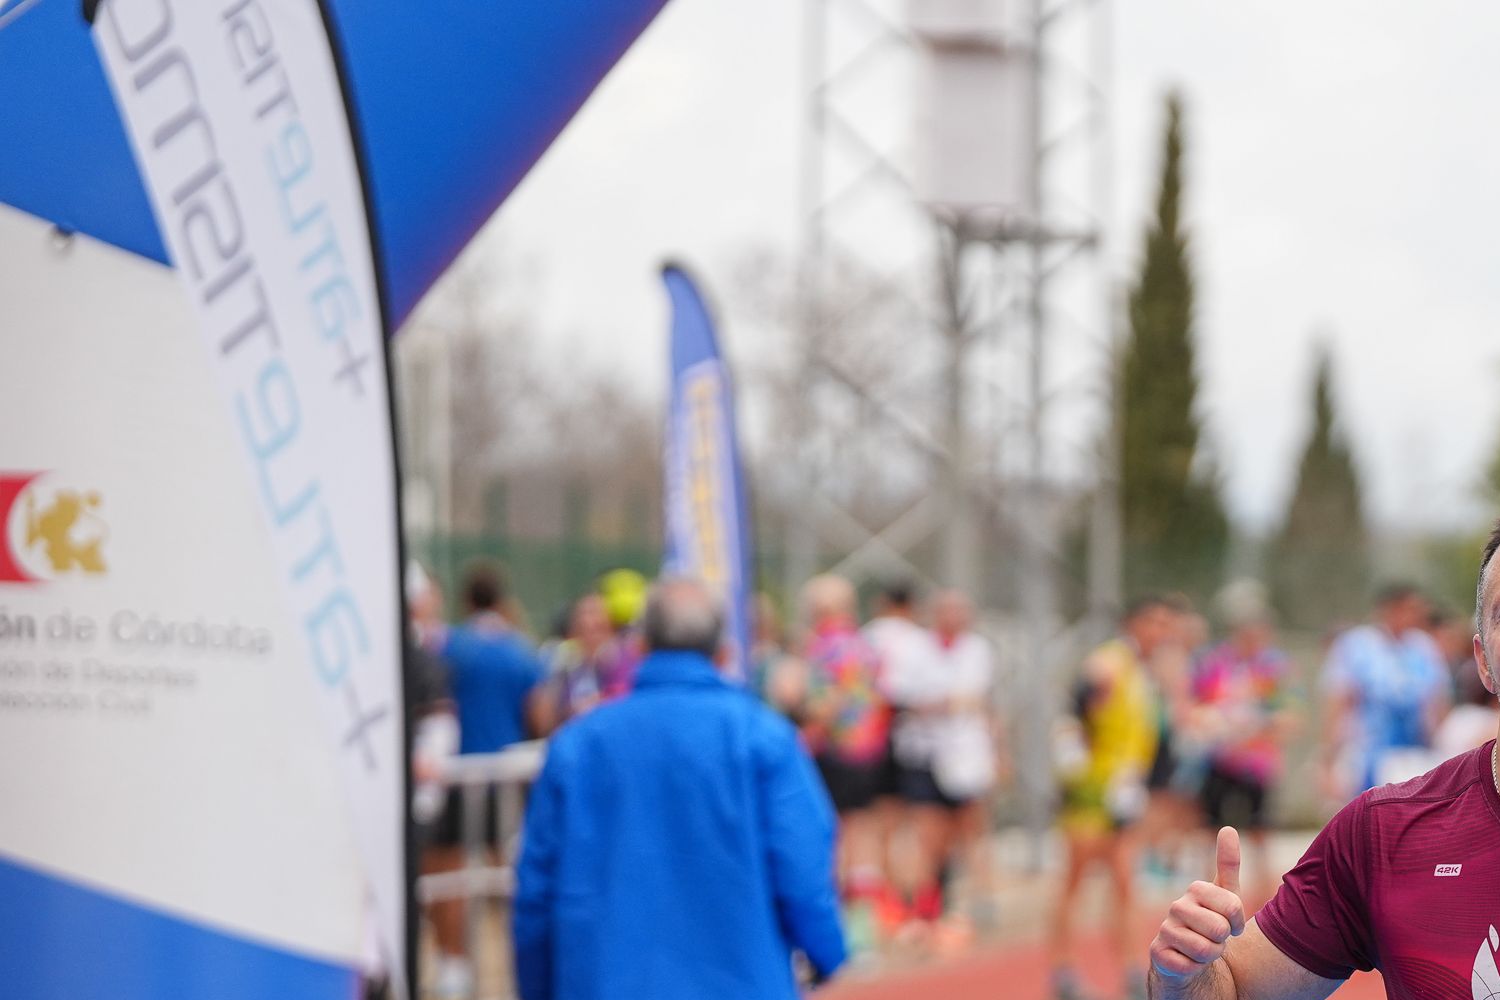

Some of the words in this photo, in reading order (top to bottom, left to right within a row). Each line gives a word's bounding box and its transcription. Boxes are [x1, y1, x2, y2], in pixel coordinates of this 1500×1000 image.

[45, 605, 97, 640] de
[109, 608, 274, 654] Córdoba
[1437, 866, 1460, 875] 42K
